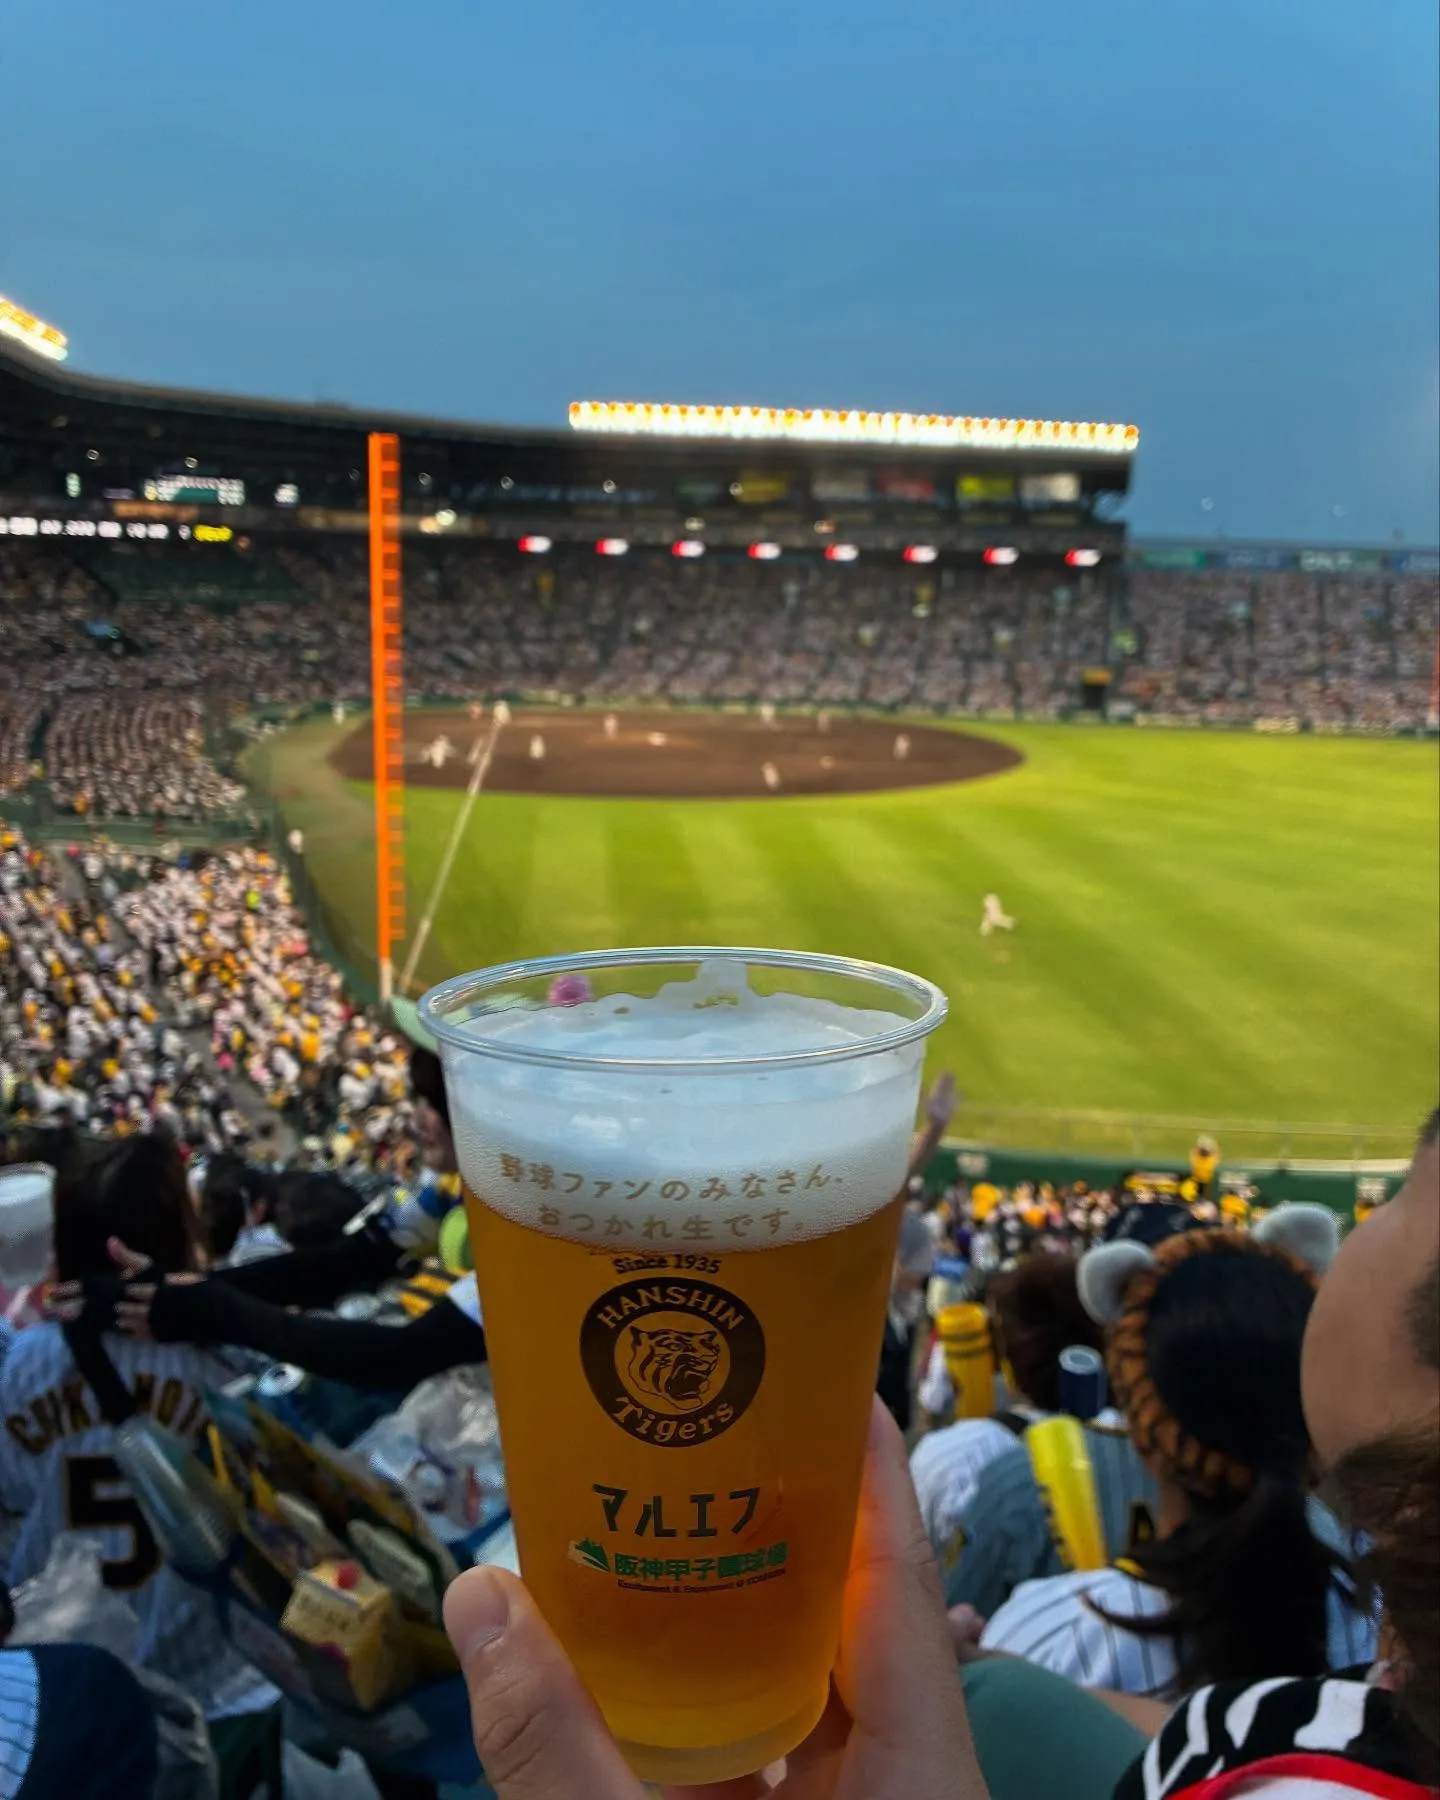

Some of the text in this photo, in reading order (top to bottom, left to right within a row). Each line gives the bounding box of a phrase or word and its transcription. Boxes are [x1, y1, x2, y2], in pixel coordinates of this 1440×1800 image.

[612, 1254, 722, 1274] Since 1935
[597, 1286, 745, 1330] HANSHIN
[613, 1397, 734, 1442] Tigers
[63, 1454, 162, 1590] 5
[592, 1484, 761, 1537] マルエフ
